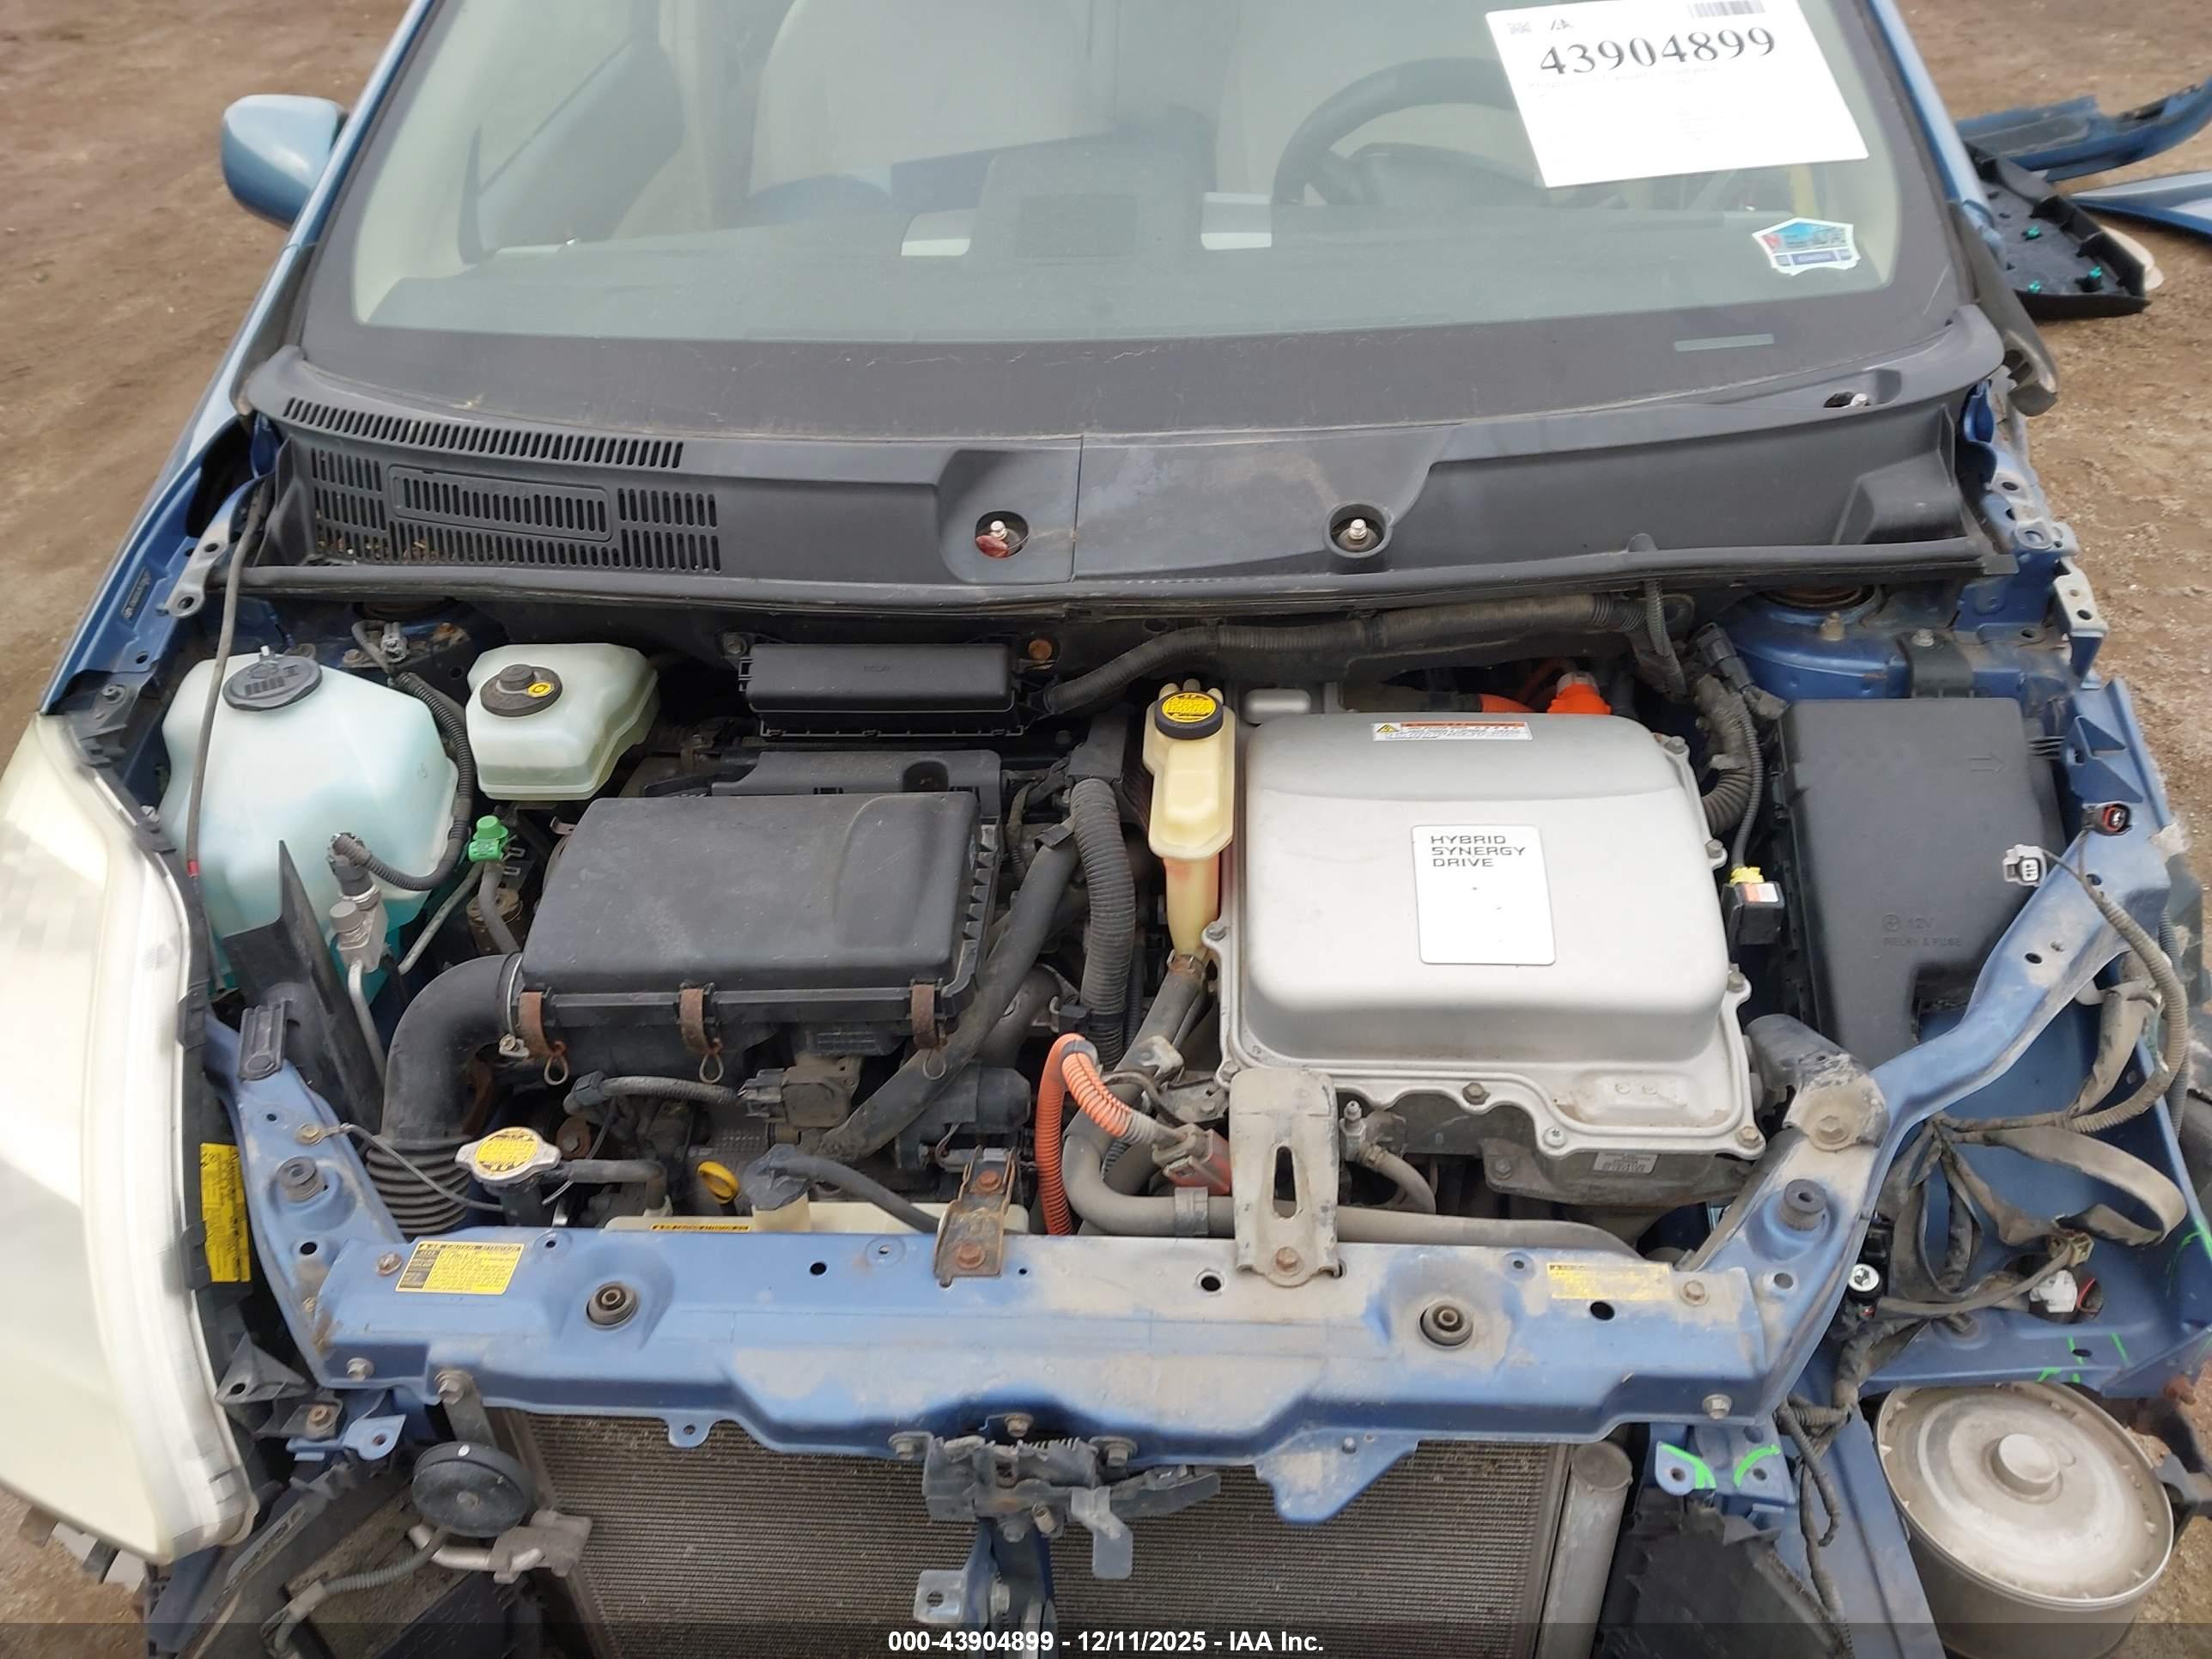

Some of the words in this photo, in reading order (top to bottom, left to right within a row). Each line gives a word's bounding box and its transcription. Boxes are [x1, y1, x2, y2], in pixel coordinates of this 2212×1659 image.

[1540, 27, 1776, 75] 43904899
[1431, 836, 1506, 844] HYBRID
[1431, 847, 1526, 856] SYNERGY
[1432, 858, 1494, 867] DRIVE
